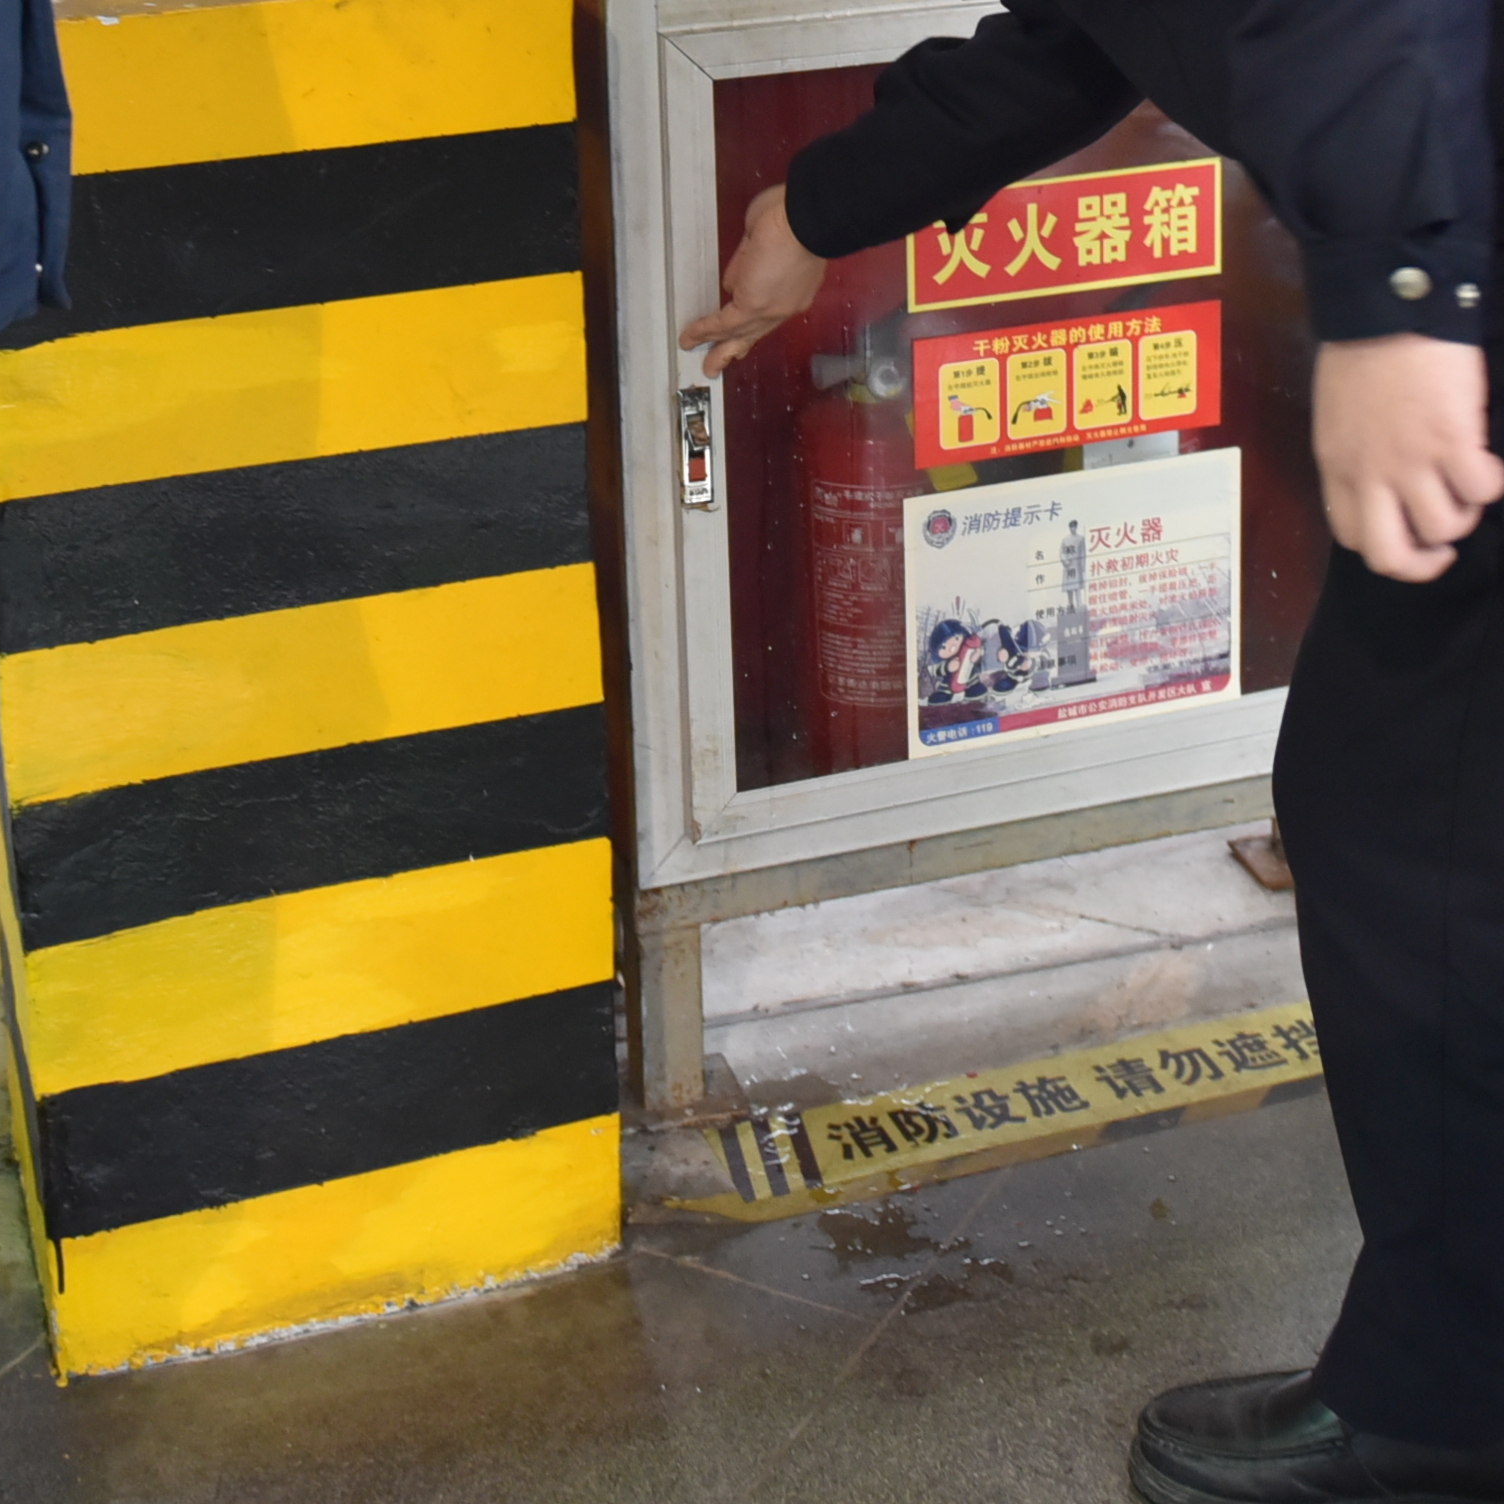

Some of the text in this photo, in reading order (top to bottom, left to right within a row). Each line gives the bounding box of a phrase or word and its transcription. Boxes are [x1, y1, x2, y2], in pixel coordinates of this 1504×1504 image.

[932, 183, 1200, 286] 灭火器箱
[972, 315, 1162, 357] 干粉灭火器的使用方法
[961, 500, 1063, 536] 消防提示卡
[1088, 517, 1163, 553] 灭火器
[1089, 548, 1180, 577] 扑救初期火灾
[827, 1073, 1091, 1162] 消防设施
